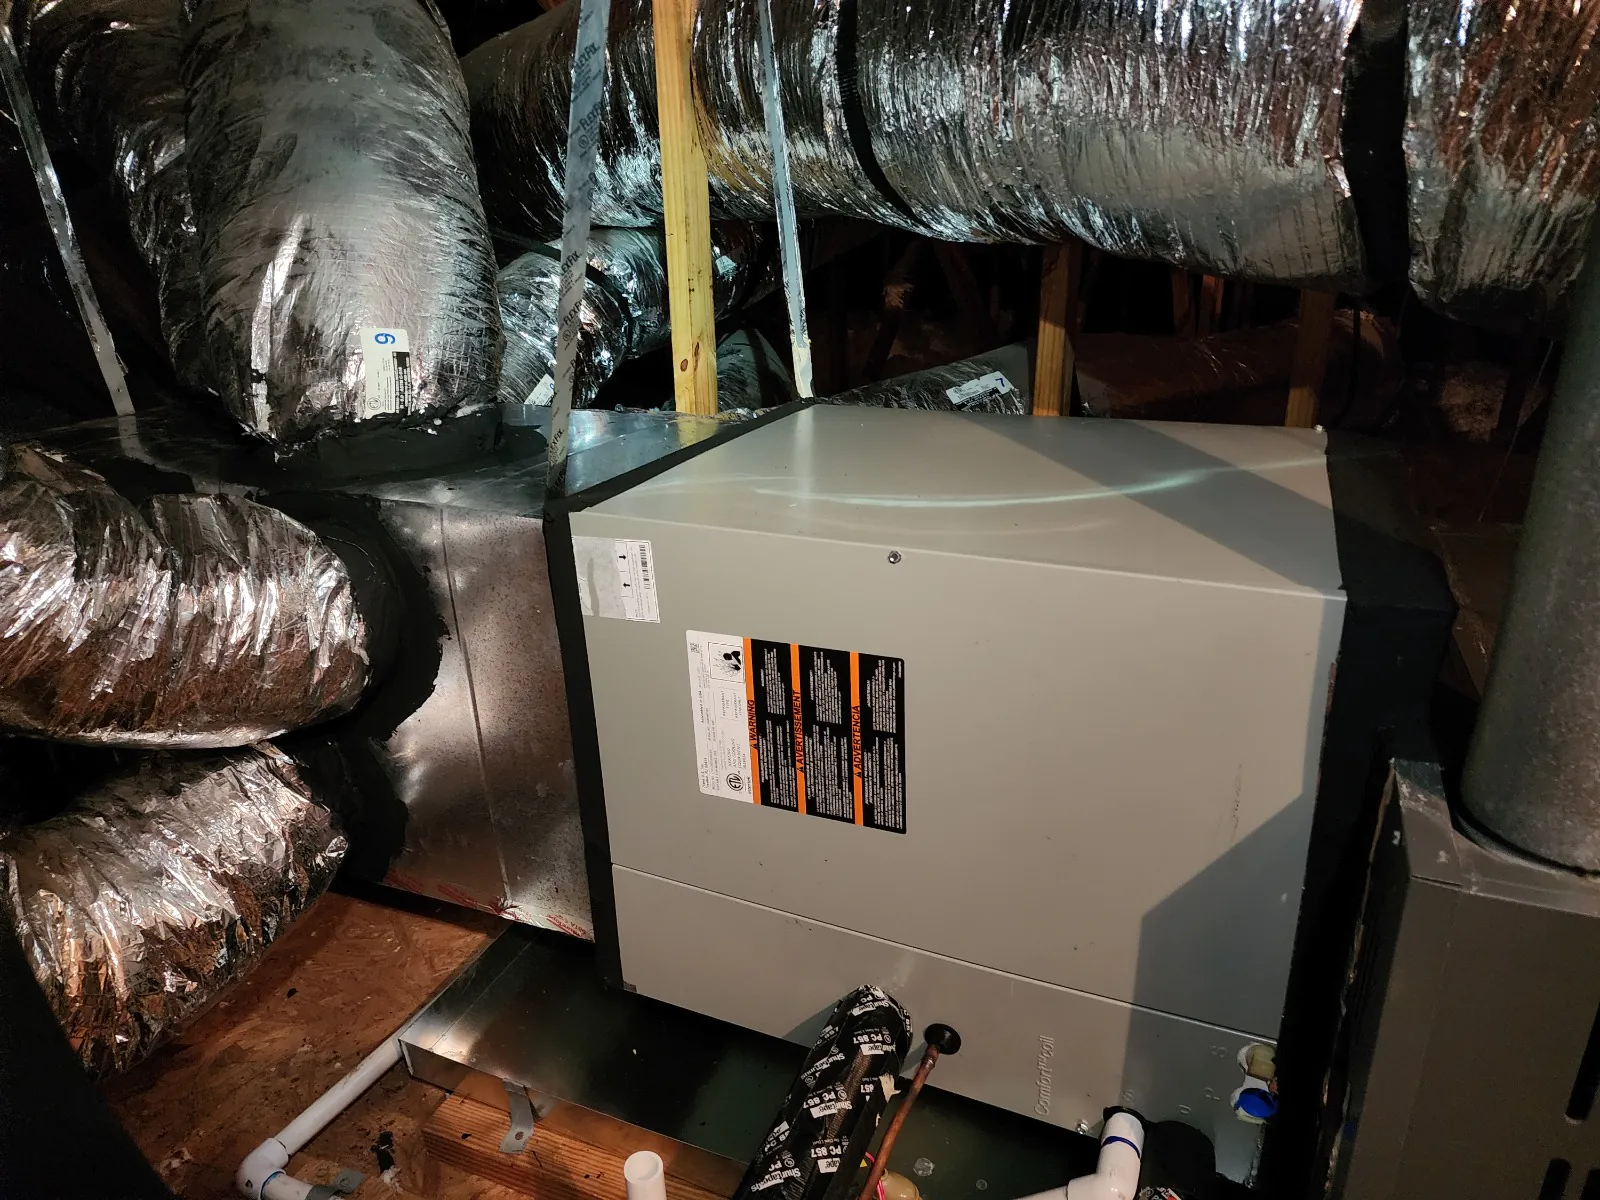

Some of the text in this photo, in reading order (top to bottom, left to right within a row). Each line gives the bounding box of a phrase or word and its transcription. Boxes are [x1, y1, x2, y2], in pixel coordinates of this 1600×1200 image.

[747, 699, 756, 741] WARNING
[792, 690, 803, 764] AVERTISSEMENT
[851, 704, 861, 770] ADVERTENCIA
[853, 1033, 883, 1044] PC 857
[822, 1091, 836, 1101] PC
[803, 1097, 820, 1109] 857
[811, 1145, 842, 1158] PC 857
